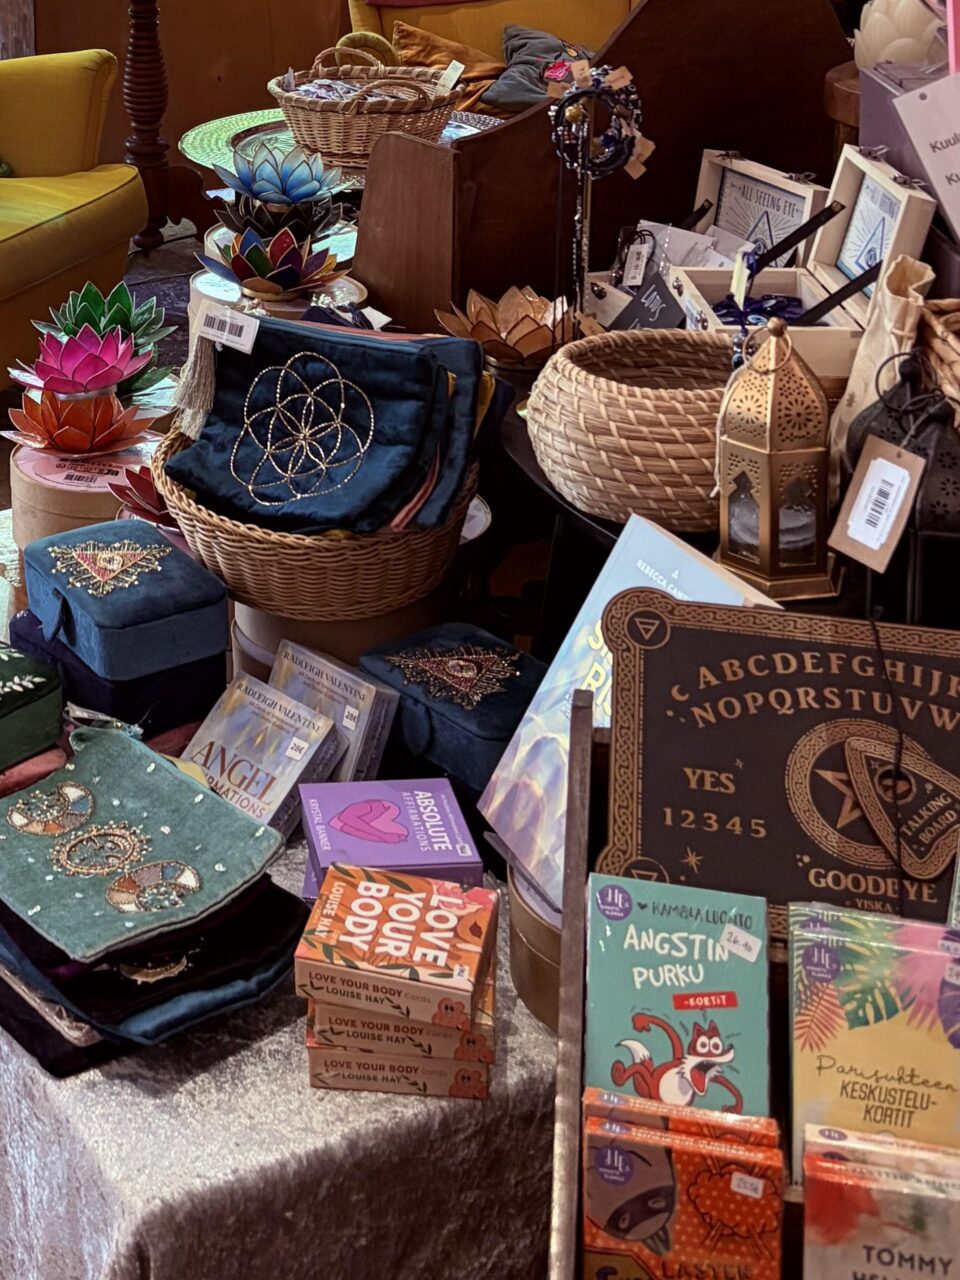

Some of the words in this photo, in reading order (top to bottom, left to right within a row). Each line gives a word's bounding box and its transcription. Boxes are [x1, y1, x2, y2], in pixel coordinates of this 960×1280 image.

[235, 681, 278, 713] RADLEIGH
[277, 702, 322, 734] VALENTINE
[290, 742, 305, 755] 28€
[190, 740, 278, 807] ANGEL
[683, 767, 736, 794] YES
[401, 791, 432, 852] AFFIRMATIONS
[413, 789, 453, 852] ABSOLUTE
[900, 791, 953, 839] TALKING
[917, 809, 958, 846] BOARD
[324, 881, 347, 917] LOUISE
[855, 898, 892, 913] YISKA
[314, 916, 332, 938] HAY
[339, 880, 390, 952] BODY
[374, 891, 427, 958] YOUR
[412, 894, 464, 967] LOVE
[623, 923, 730, 962] ANGSTIN
[308, 971, 340, 984] LOVE
[339, 977, 371, 991] YOUR
[372, 983, 403, 998] BODY
[632, 963, 705, 990] PURKU
[326, 986, 363, 1001] LOUISE
[365, 994, 386, 1006] HAY
[328, 1016, 358, 1028] LOVE
[360, 1021, 390, 1032] YOUR
[393, 1025, 424, 1036] BODY
[346, 1030, 384, 1042] LOUISE
[386, 1035, 408, 1045] HAY
[324, 1059, 353, 1069] LOVE
[355, 1062, 386, 1072] YOUR
[388, 1065, 419, 1075] BODY
[341, 1072, 379, 1082] LOUISE
[381, 1075, 403, 1084] HAY
[816, 1054, 958, 1093] Parisuhteen
[840, 1081, 938, 1111] KESKUSTELU-
[863, 1104, 916, 1128] KORTIT
[862, 1245, 953, 1277] TOMMY
